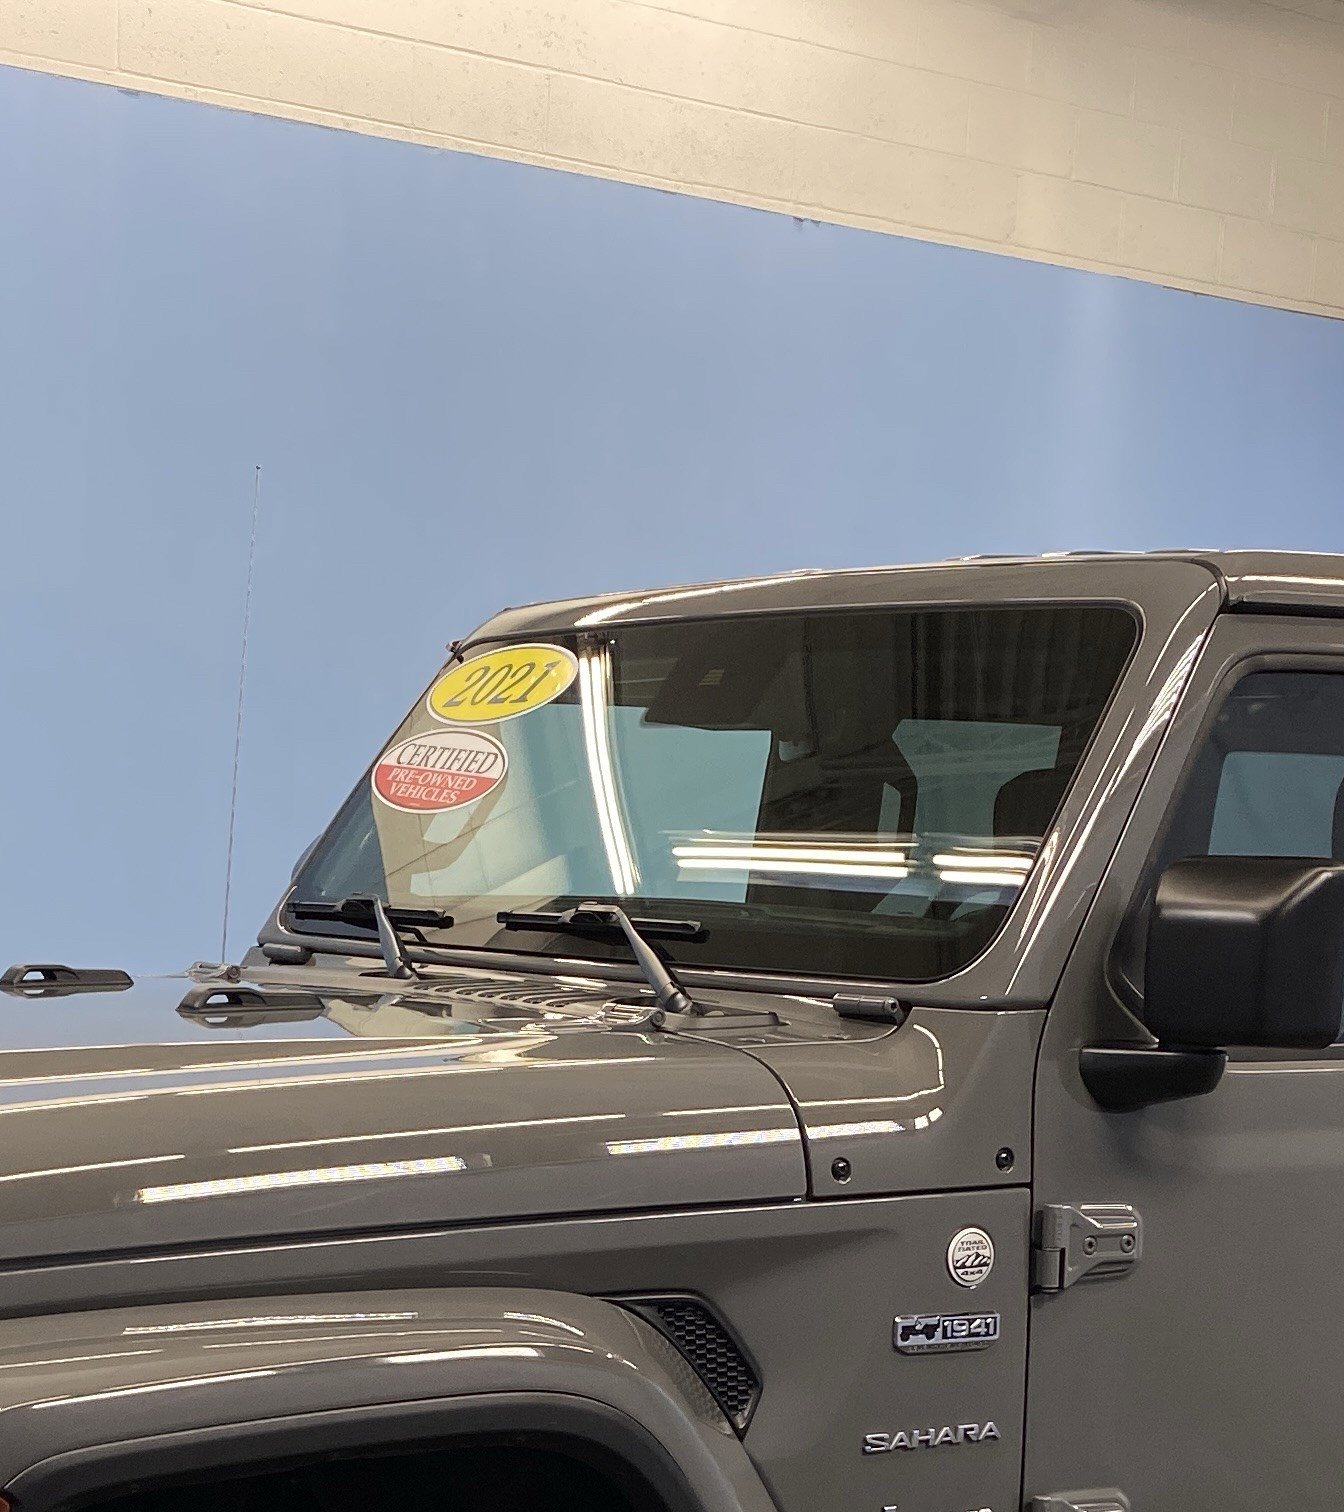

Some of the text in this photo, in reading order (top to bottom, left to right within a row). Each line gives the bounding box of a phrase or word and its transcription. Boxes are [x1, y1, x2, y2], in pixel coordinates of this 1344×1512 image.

[442, 660, 561, 708] 2021
[396, 743, 499, 775] CERTIFIED
[387, 767, 478, 791] PRE-OWNED
[389, 782, 460, 803] VEHICLES
[943, 1317, 996, 1338] 1941
[863, 1421, 1002, 1455] SAHARA
